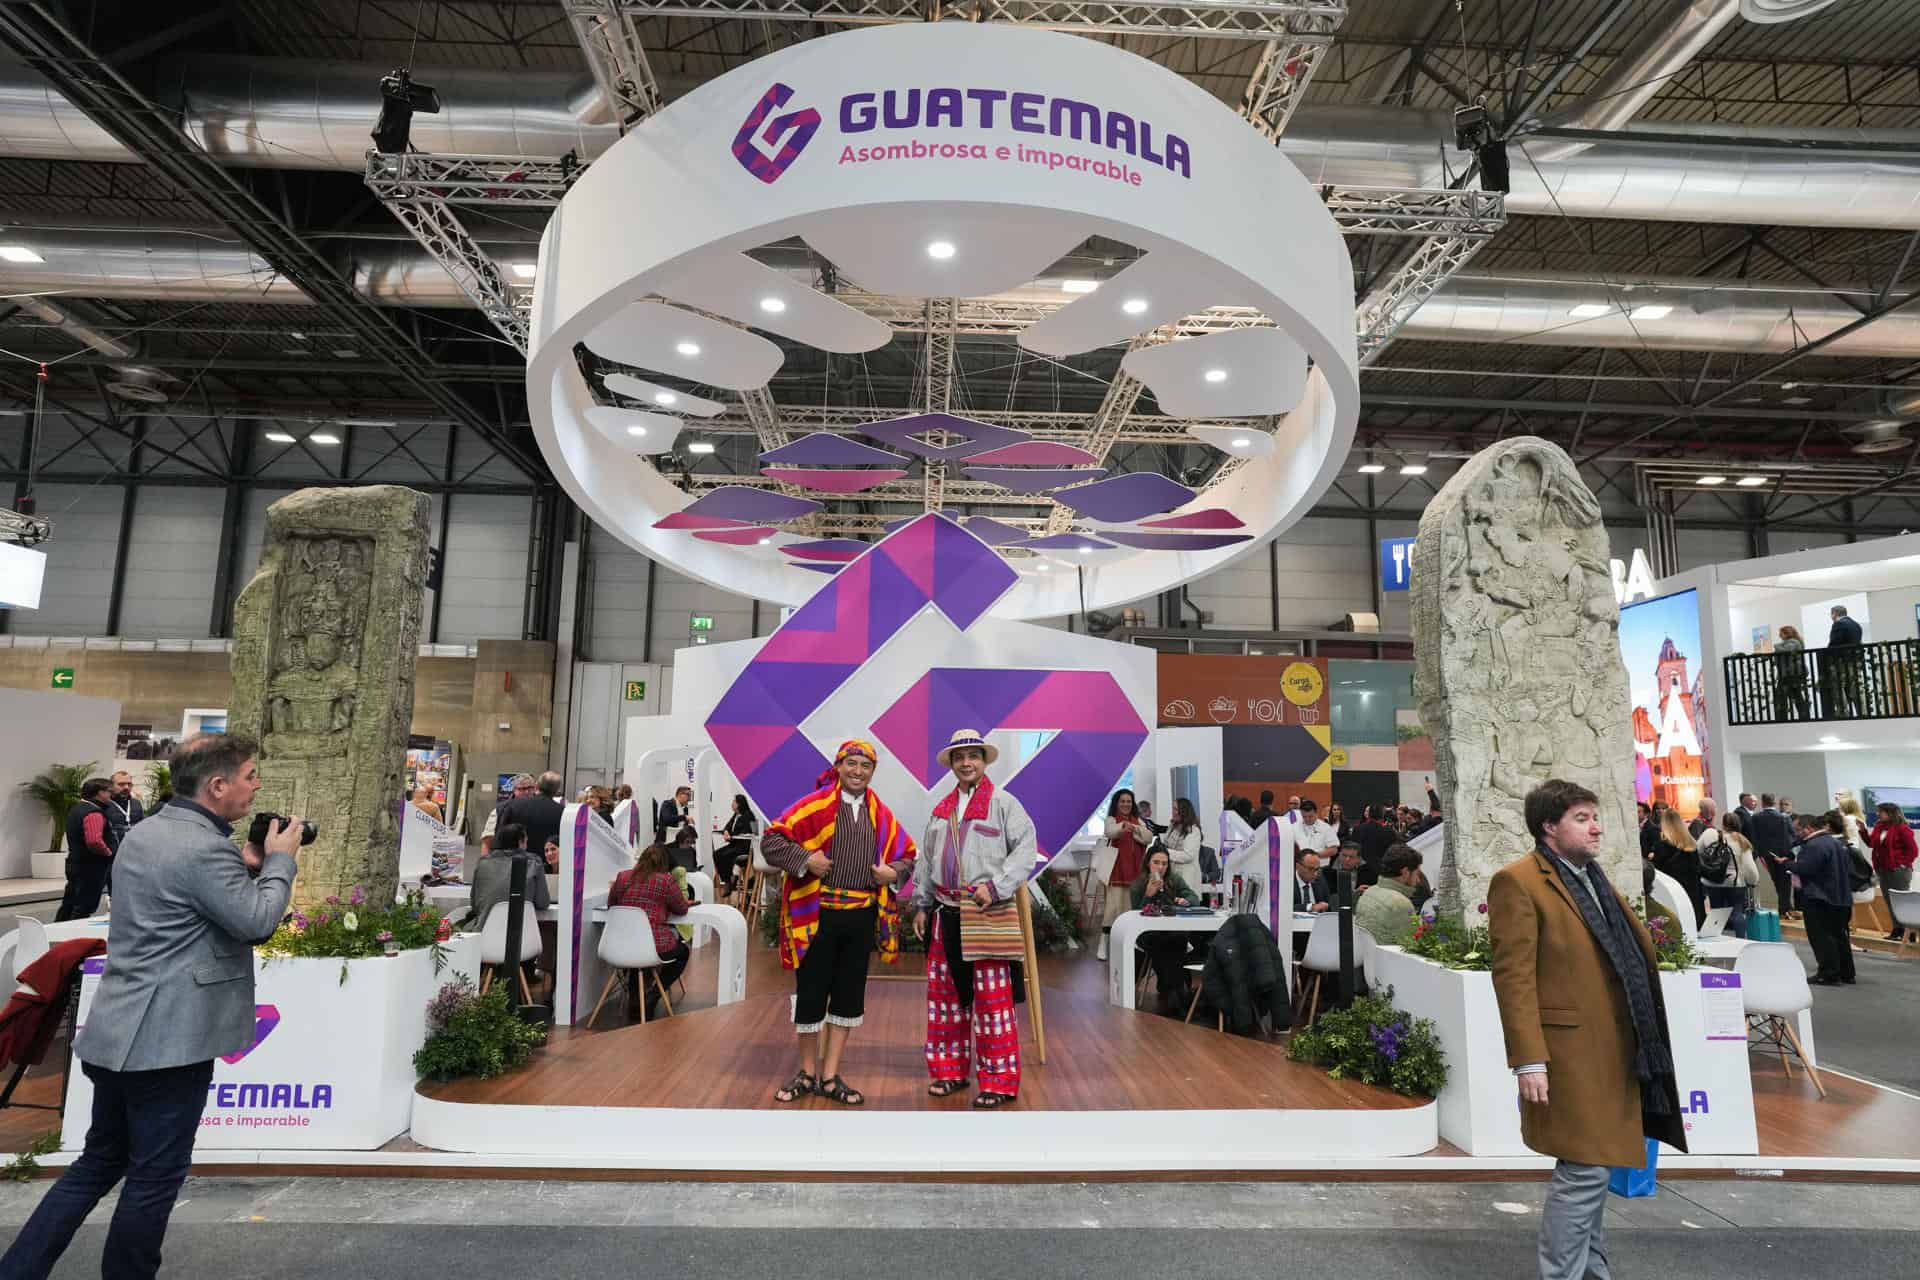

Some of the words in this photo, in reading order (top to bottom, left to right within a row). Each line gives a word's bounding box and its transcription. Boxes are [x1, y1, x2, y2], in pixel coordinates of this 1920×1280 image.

[839, 88, 1191, 179] GUATEMALA
[838, 139, 987, 165] Asombrosa
[995, 147, 1011, 161] e
[1017, 143, 1142, 187] imparable
[225, 1117, 234, 1126] e
[237, 1114, 310, 1128] imparable
